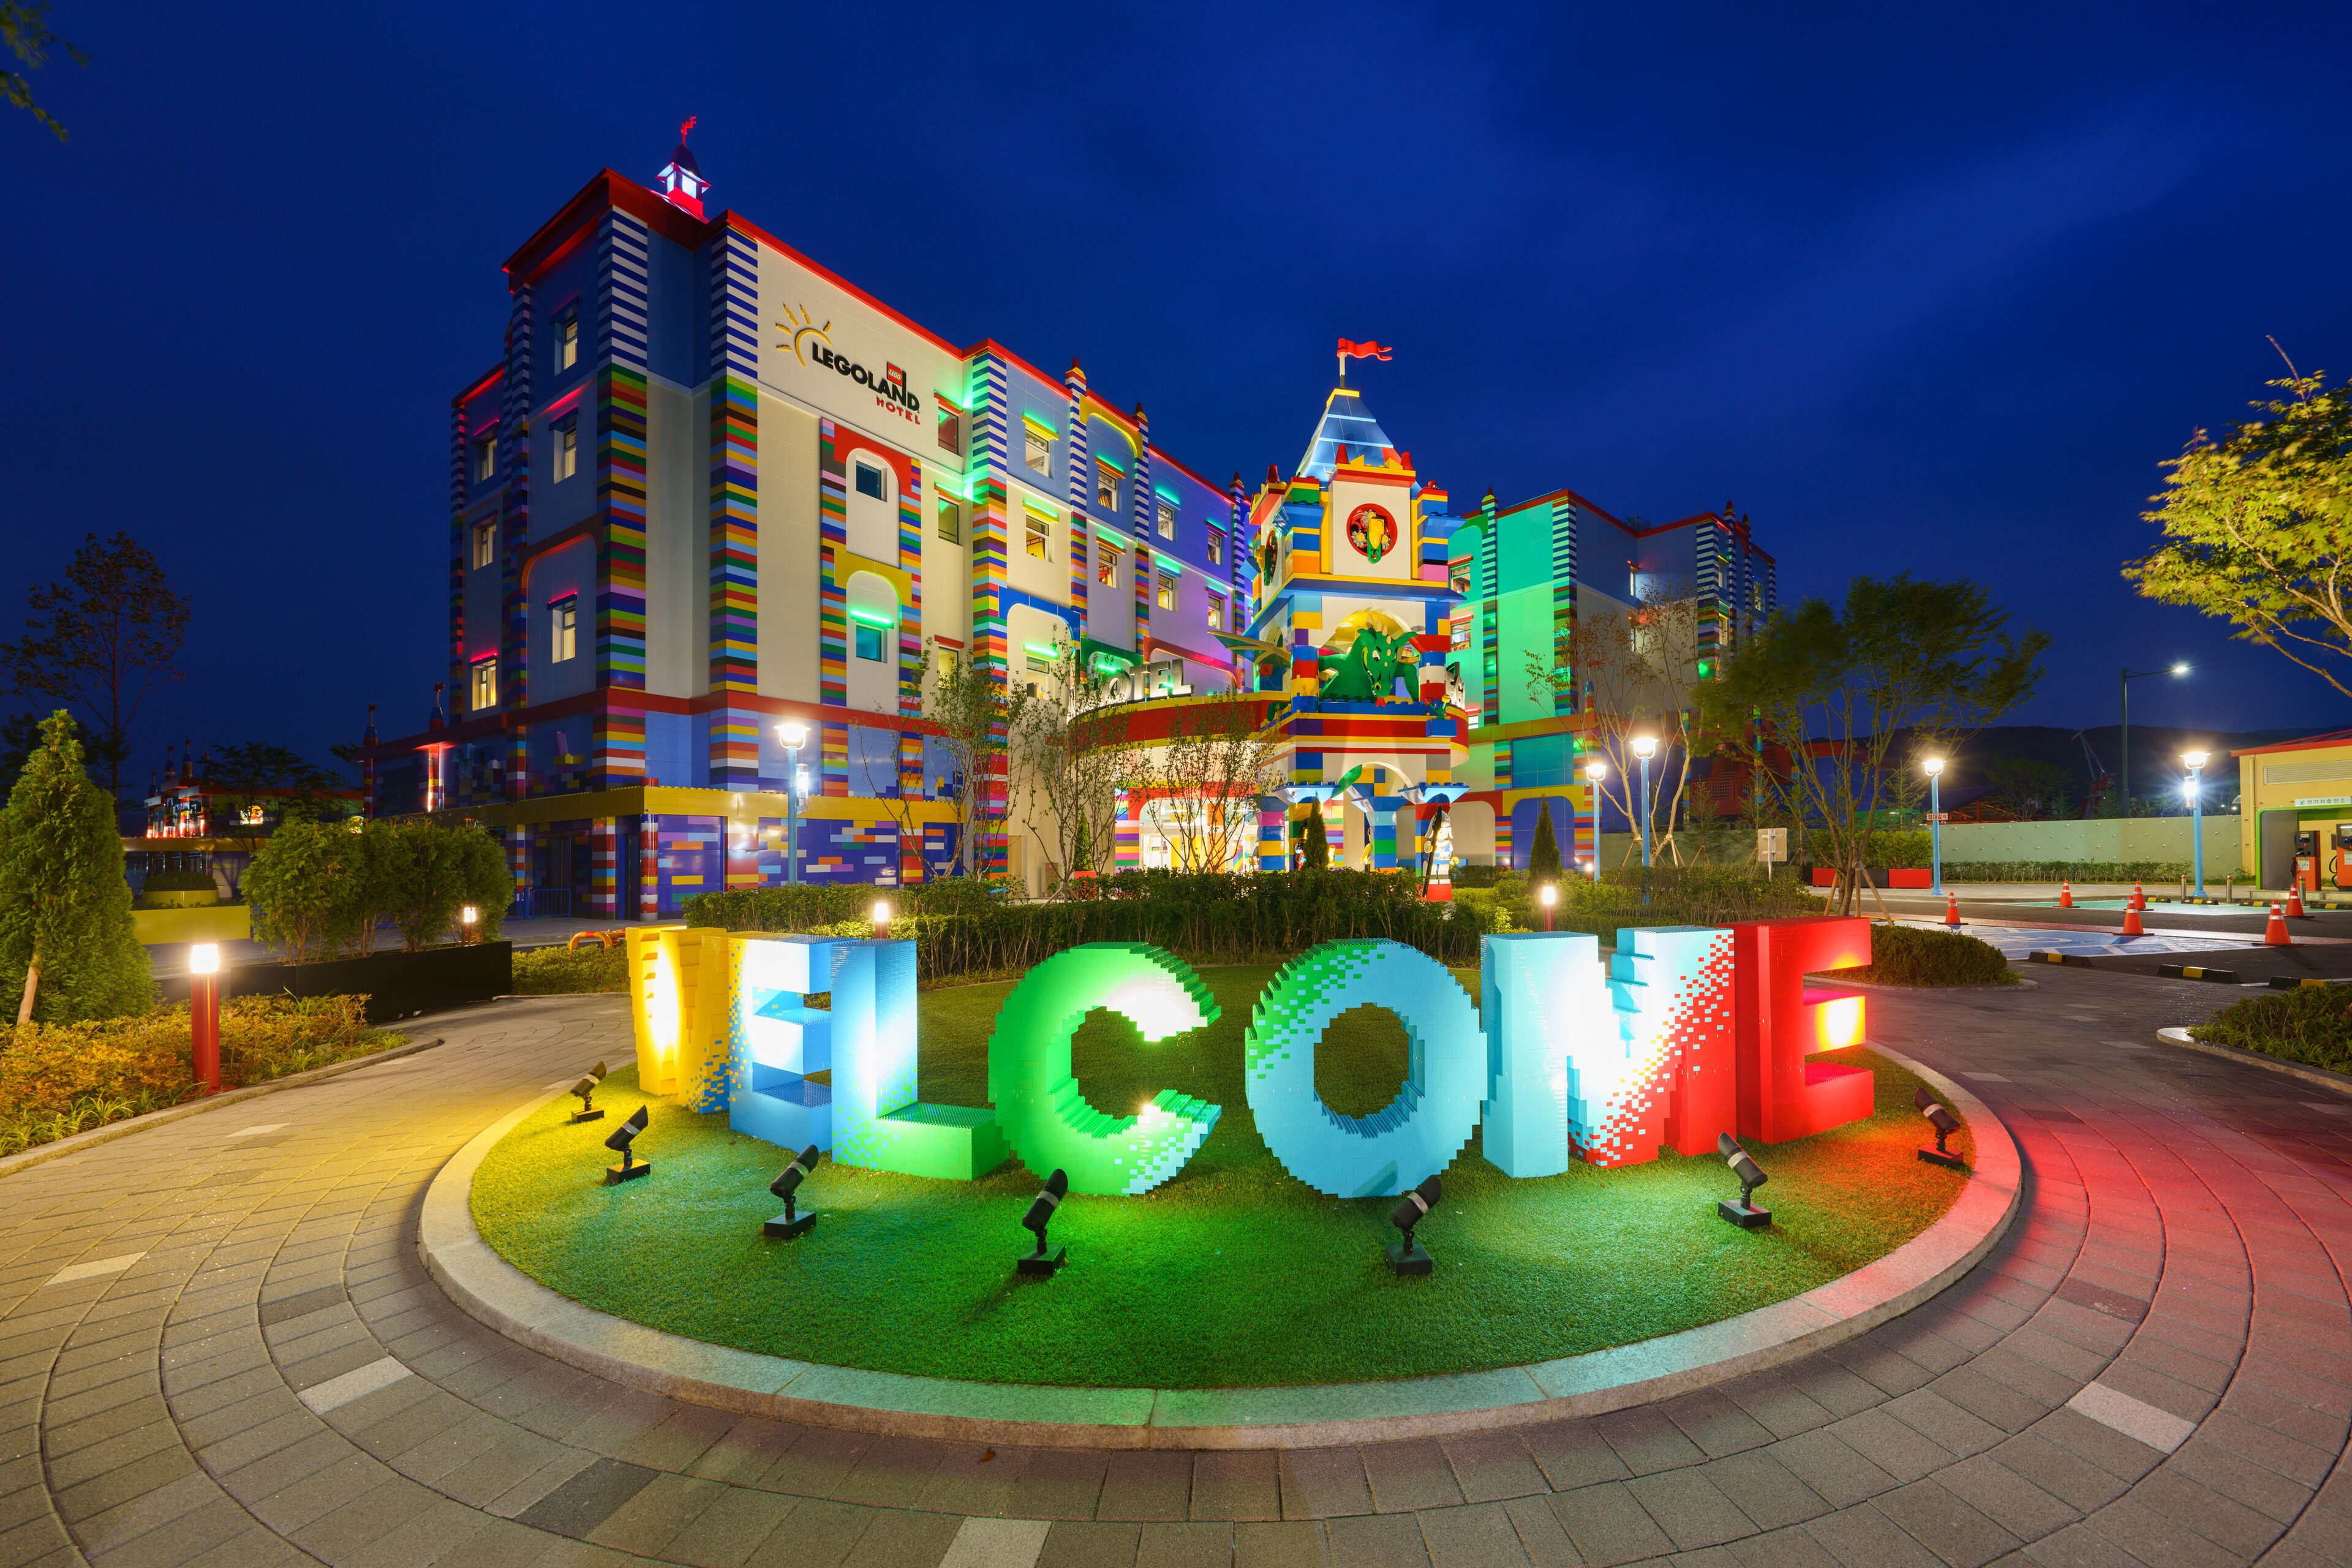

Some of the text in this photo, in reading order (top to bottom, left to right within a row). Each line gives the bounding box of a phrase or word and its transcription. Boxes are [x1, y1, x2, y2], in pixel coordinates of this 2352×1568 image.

[812, 341, 920, 412] LEGOLAND
[889, 369, 901, 380] LEGO
[876, 396, 921, 425] HOTEL
[625, 915, 1874, 1198] WELCOME
